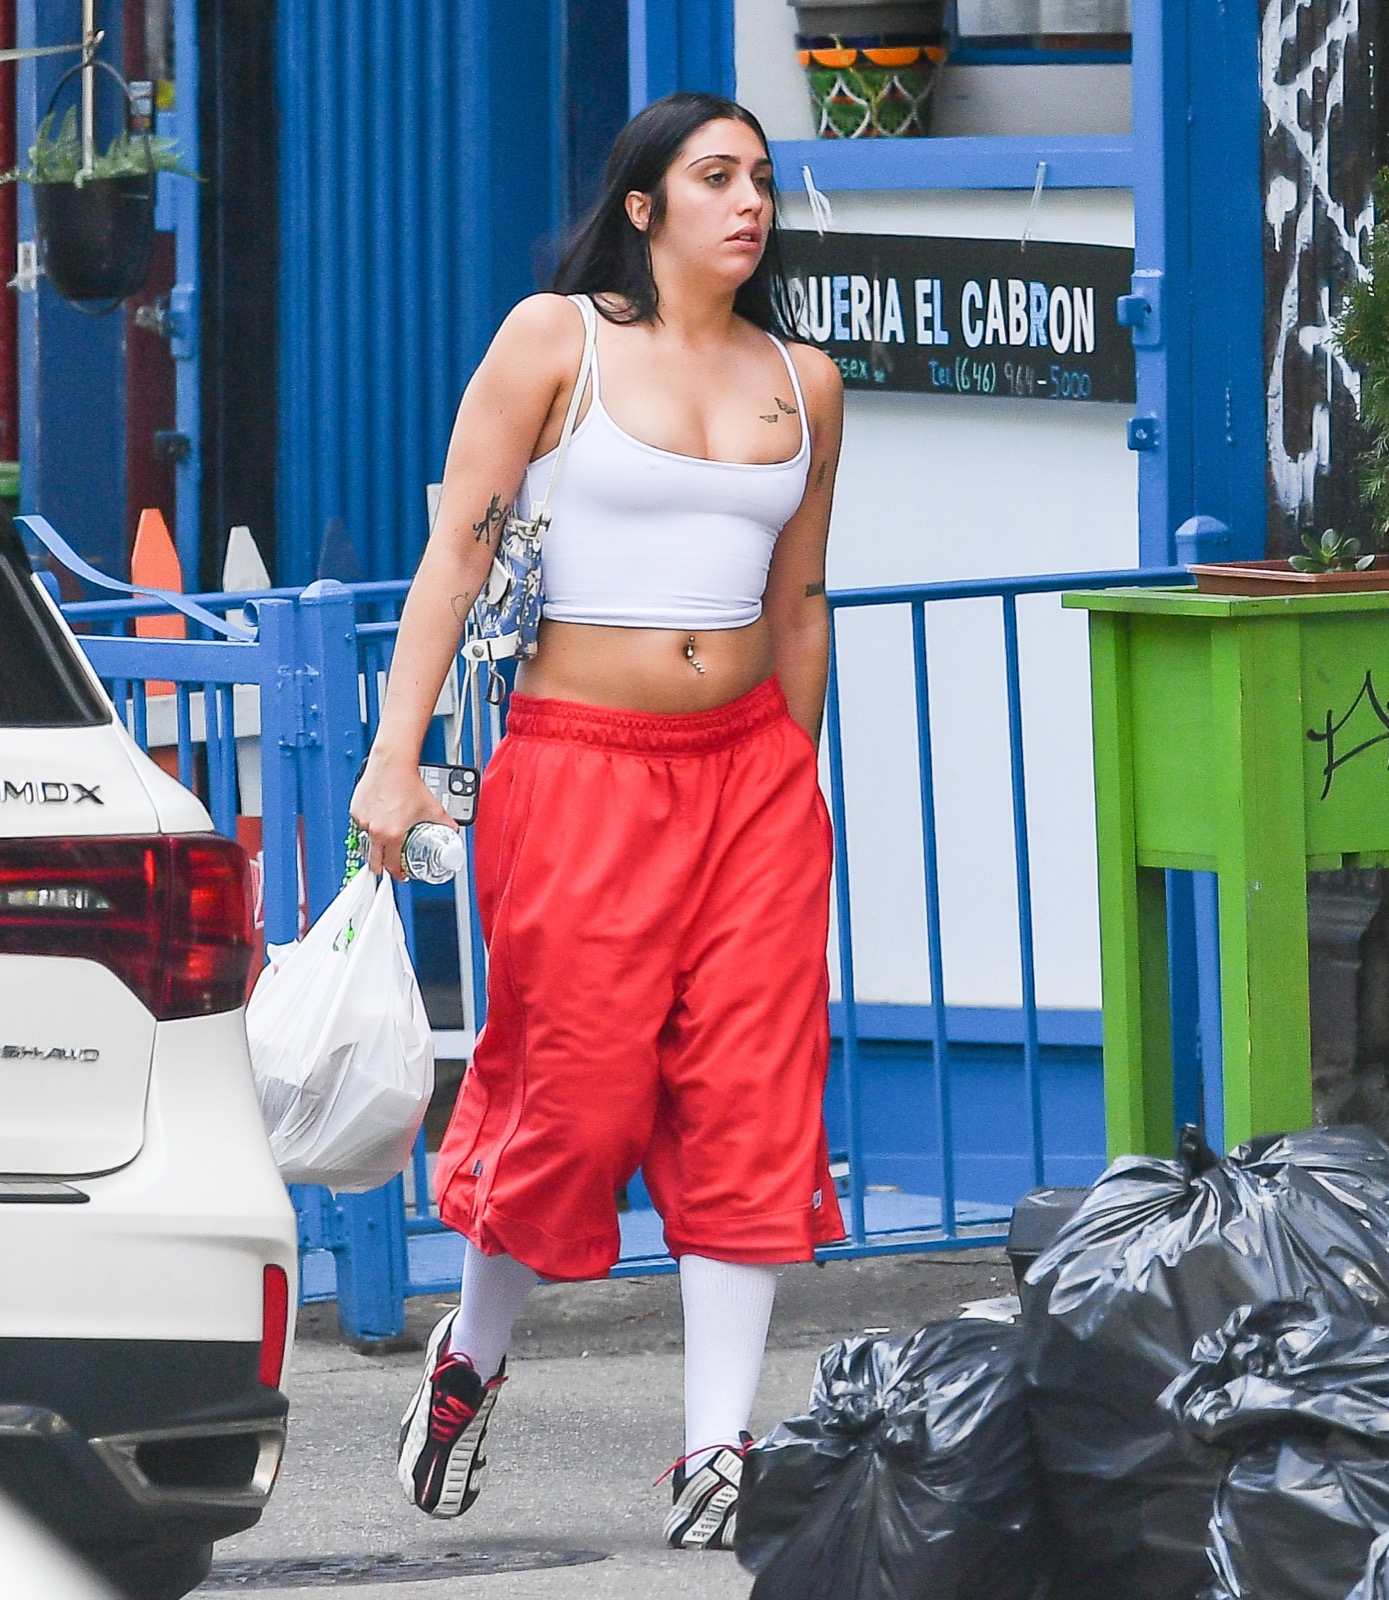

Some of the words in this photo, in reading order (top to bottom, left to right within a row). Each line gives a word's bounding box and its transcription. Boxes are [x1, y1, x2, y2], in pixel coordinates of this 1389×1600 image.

[773, 274, 905, 343] QUERIA
[914, 278, 949, 344] EL
[962, 278, 1095, 353] CABRON
[824, 349, 869, 380] sex
[955, 356, 996, 393] (646)
[0, 781, 104, 805] MDX
